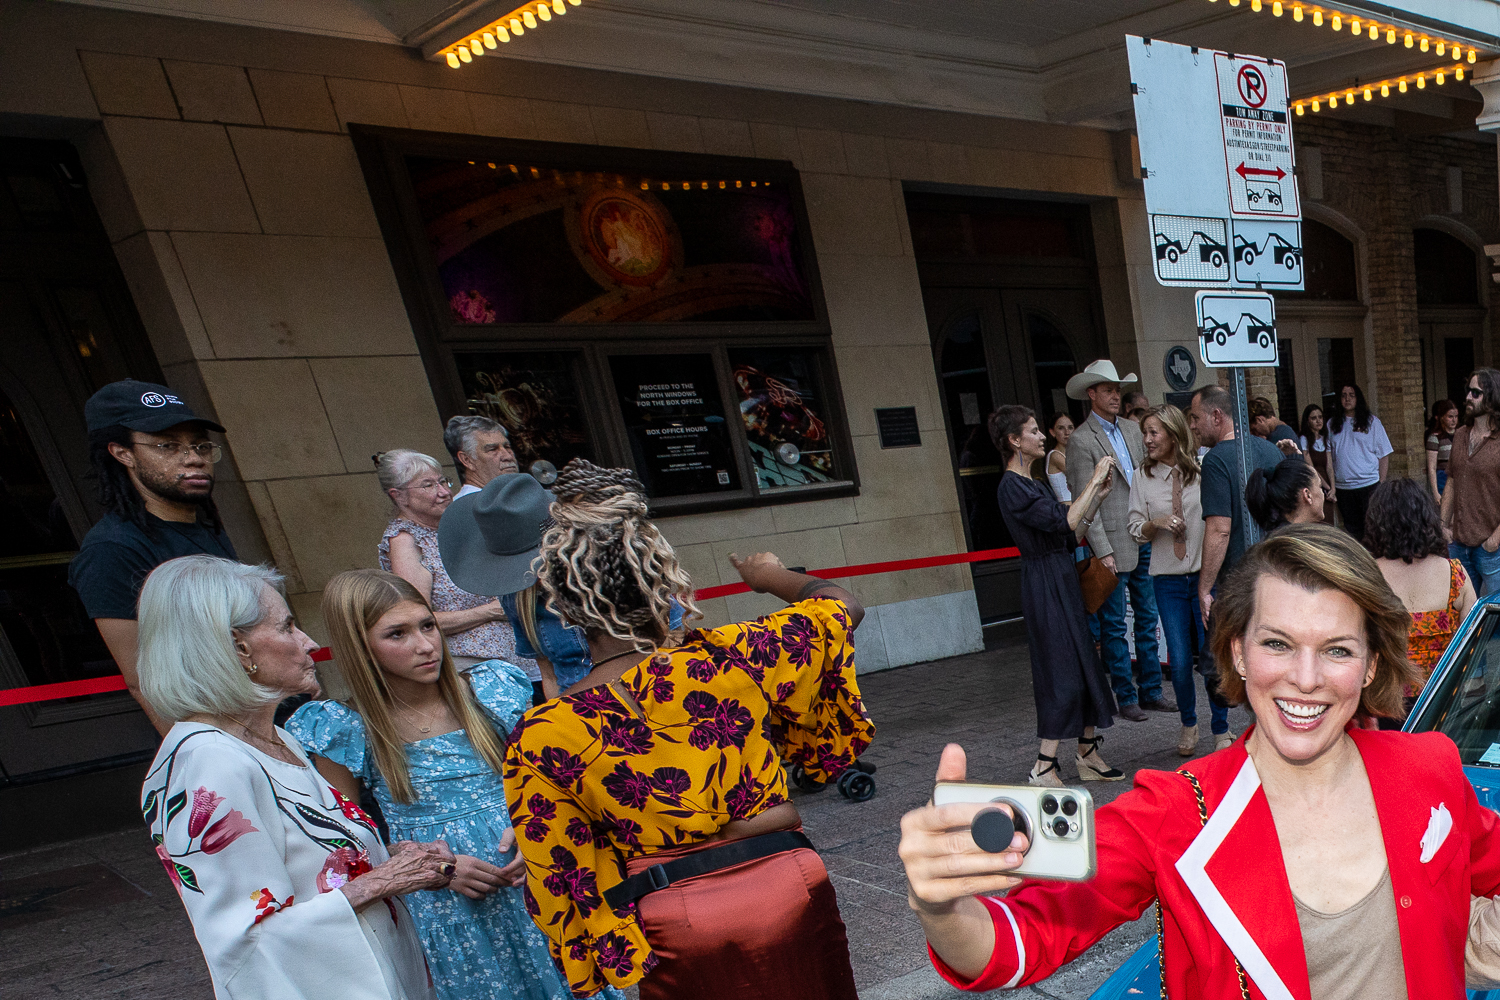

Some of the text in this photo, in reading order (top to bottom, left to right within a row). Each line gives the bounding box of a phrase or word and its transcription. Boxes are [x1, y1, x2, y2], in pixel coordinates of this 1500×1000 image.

[1236, 107, 1274, 121] TOW AWAY ZONE
[1226, 118, 1286, 134] PARKING BY PERMIT ONLY
[1233, 128, 1282, 141] FOR PERMIT INFORMATION
[144, 394, 162, 404] AFS
[646, 428, 661, 436] BOX
[661, 427, 685, 435] OFFICE
